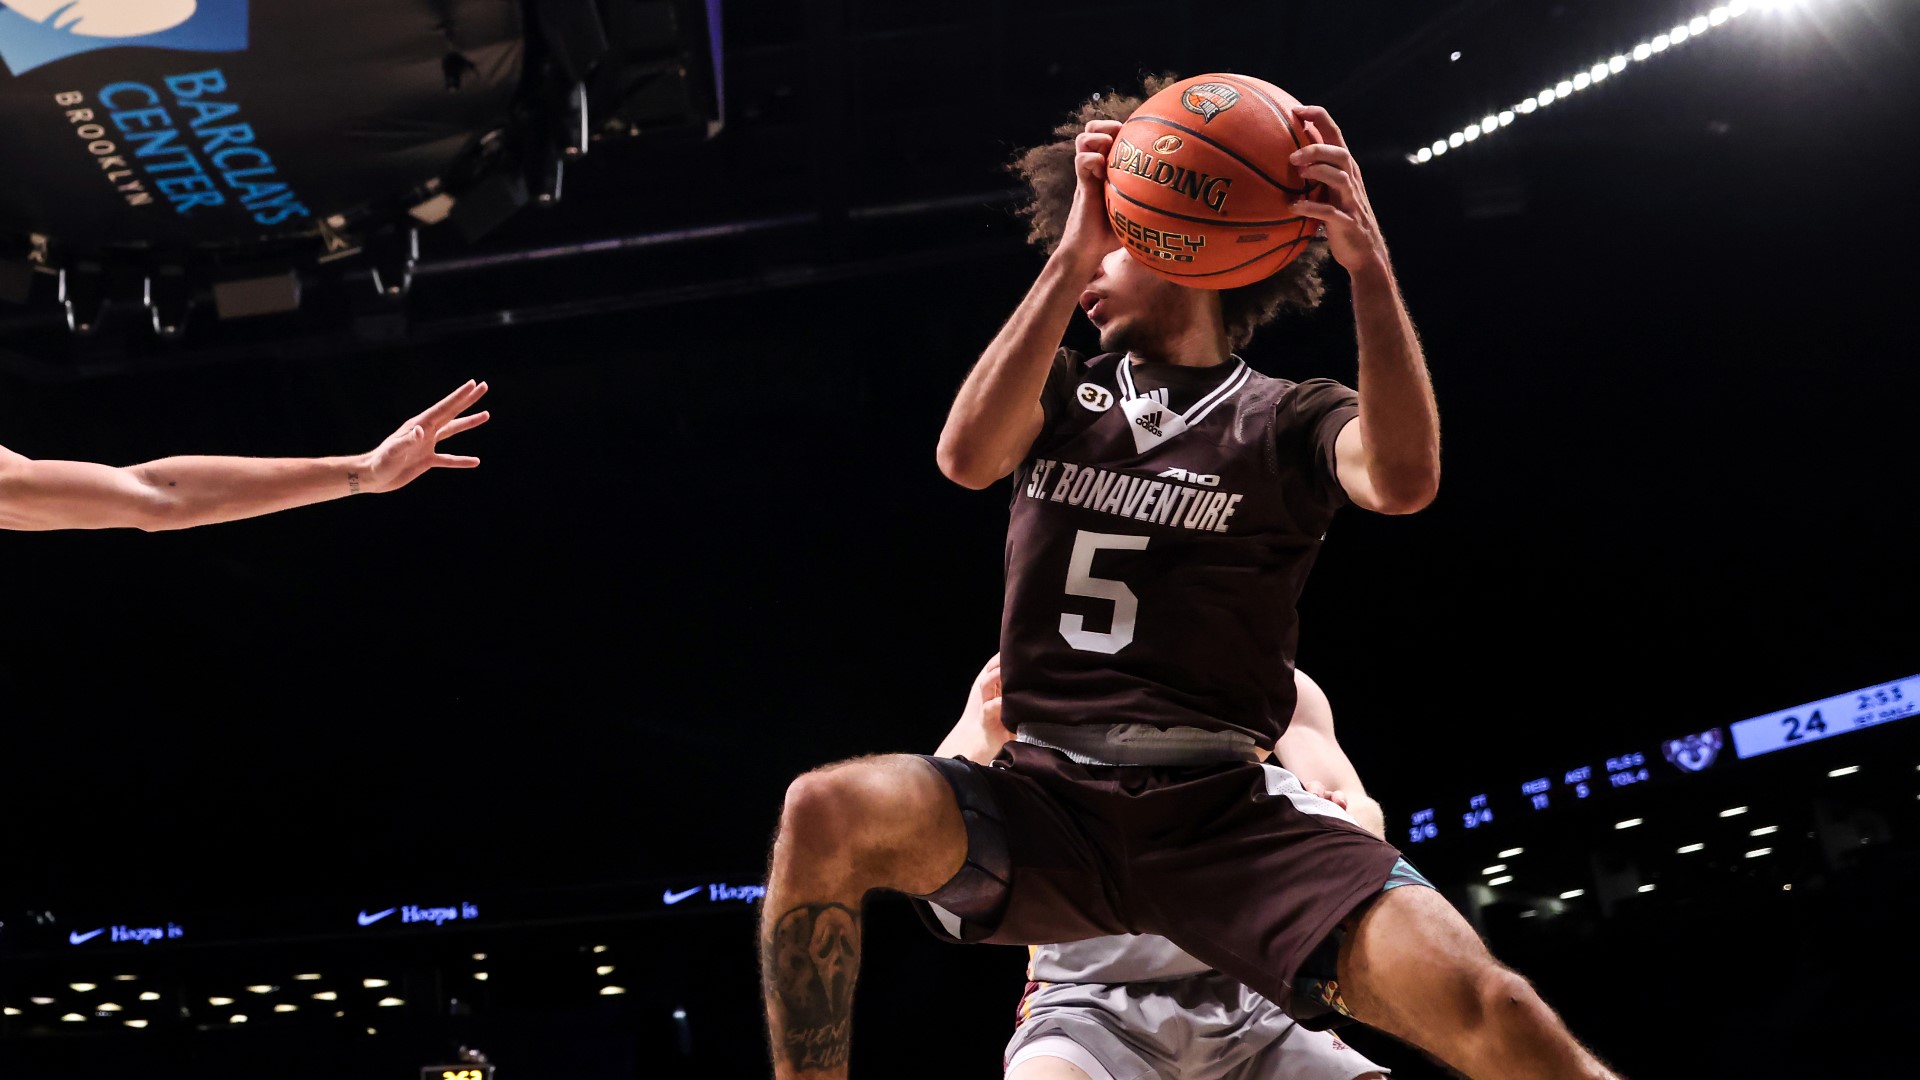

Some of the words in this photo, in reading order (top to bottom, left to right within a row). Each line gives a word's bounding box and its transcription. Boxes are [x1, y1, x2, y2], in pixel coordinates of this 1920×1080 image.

[54, 90, 154, 206] BROOKLYN
[97, 81, 225, 214] CENTER
[163, 67, 310, 225] BARCLAYS
[1109, 138, 1232, 213] SPALDING
[1081, 386, 1108, 408] 31
[1135, 417, 1163, 437] adidas
[1026, 458, 1056, 499] ST.
[1050, 463, 1244, 533] BONAVENTURE
[1157, 466, 1221, 487] A10
[1059, 529, 1150, 654] 5
[1781, 708, 1828, 741] 24
